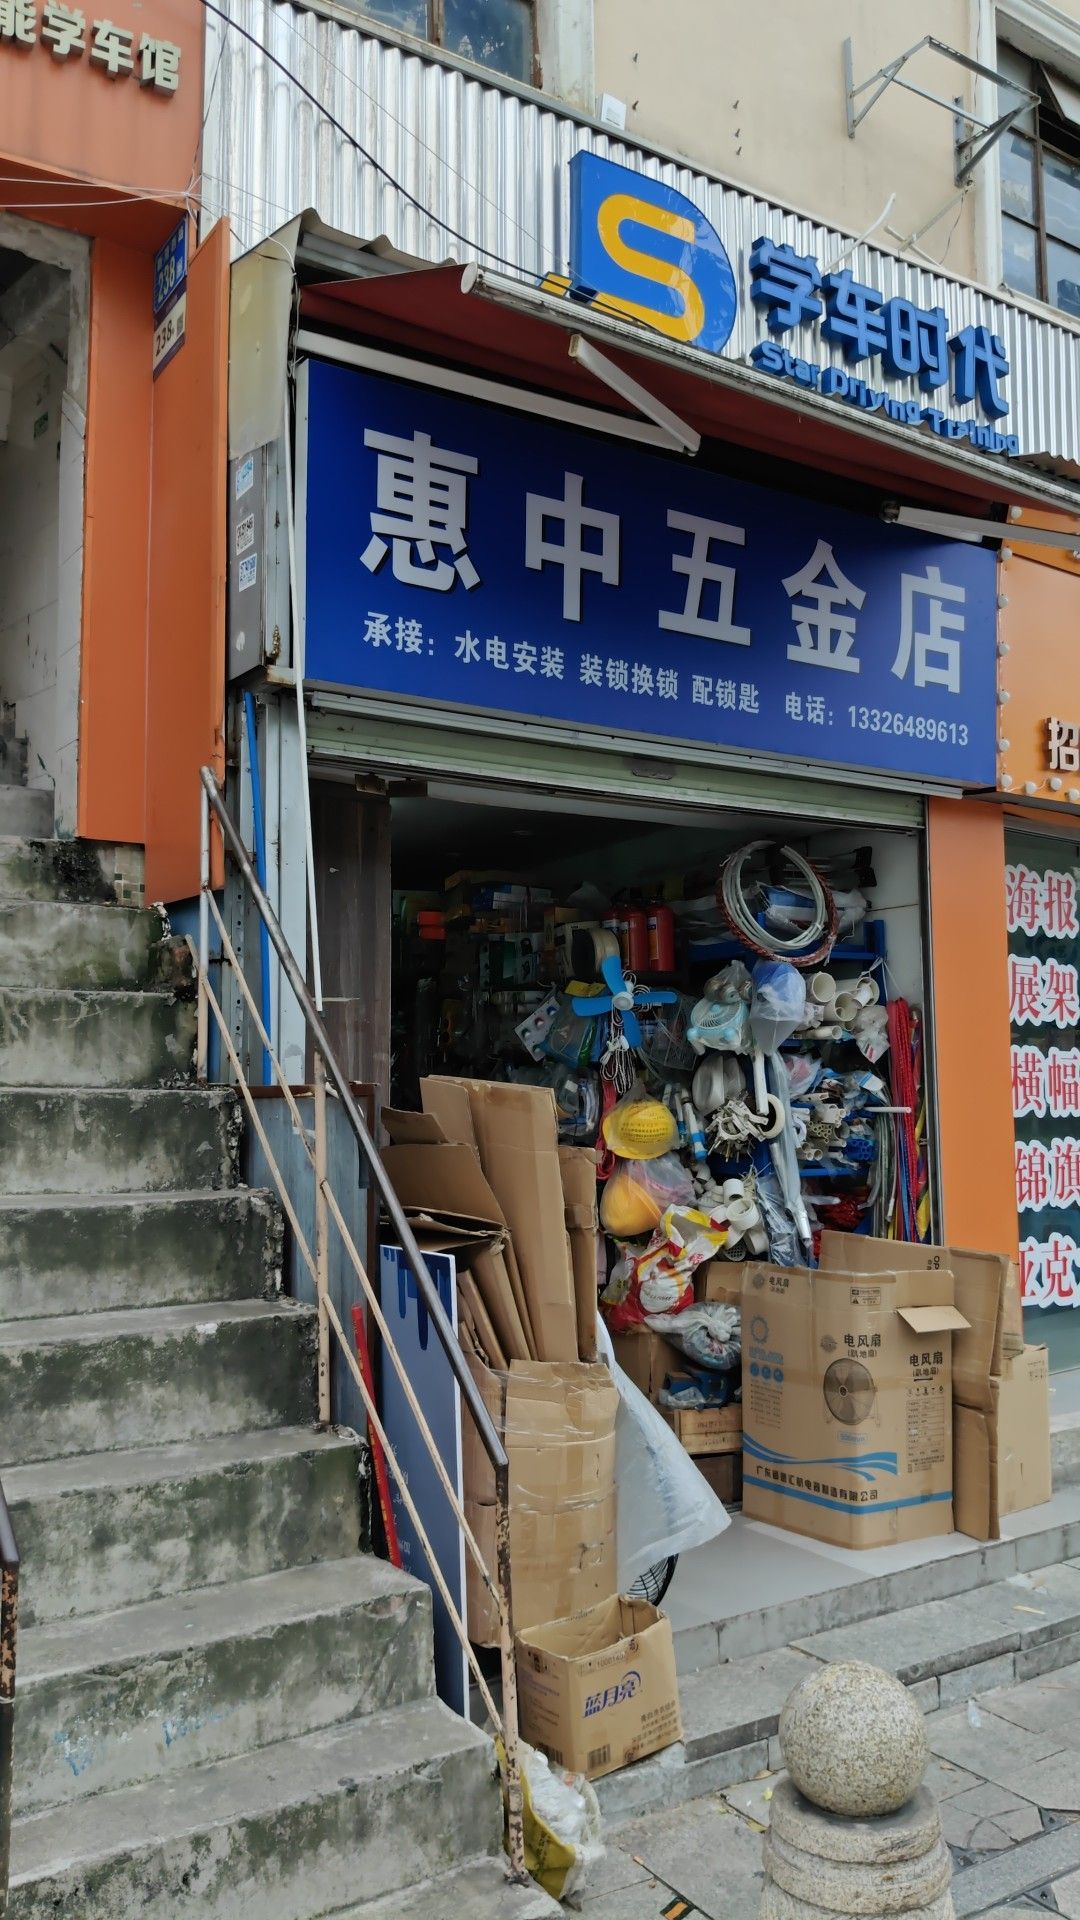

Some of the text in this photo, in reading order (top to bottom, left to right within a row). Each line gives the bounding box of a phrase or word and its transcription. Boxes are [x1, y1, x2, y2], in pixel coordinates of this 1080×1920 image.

[751, 236, 1009, 419] 学车时代
[752, 341, 820, 388] Star
[360, 428, 966, 694] 惠中五金店
[363, 611, 969, 746] 承接： 水电安装 装锁换锁 配锁匙 电话： 13326489613
[1048, 716, 1080, 772] 招
[1006, 868, 1077, 934] 海报
[1009, 959, 1077, 1023] 展架
[1010, 1051, 1079, 1111] 横幅
[1015, 1143, 1080, 1205] 锦旗
[844, 1333, 881, 1347] 电风扇
[909, 1350, 943, 1366] 电风扇
[583, 1675, 639, 1719] 蓝月亮
